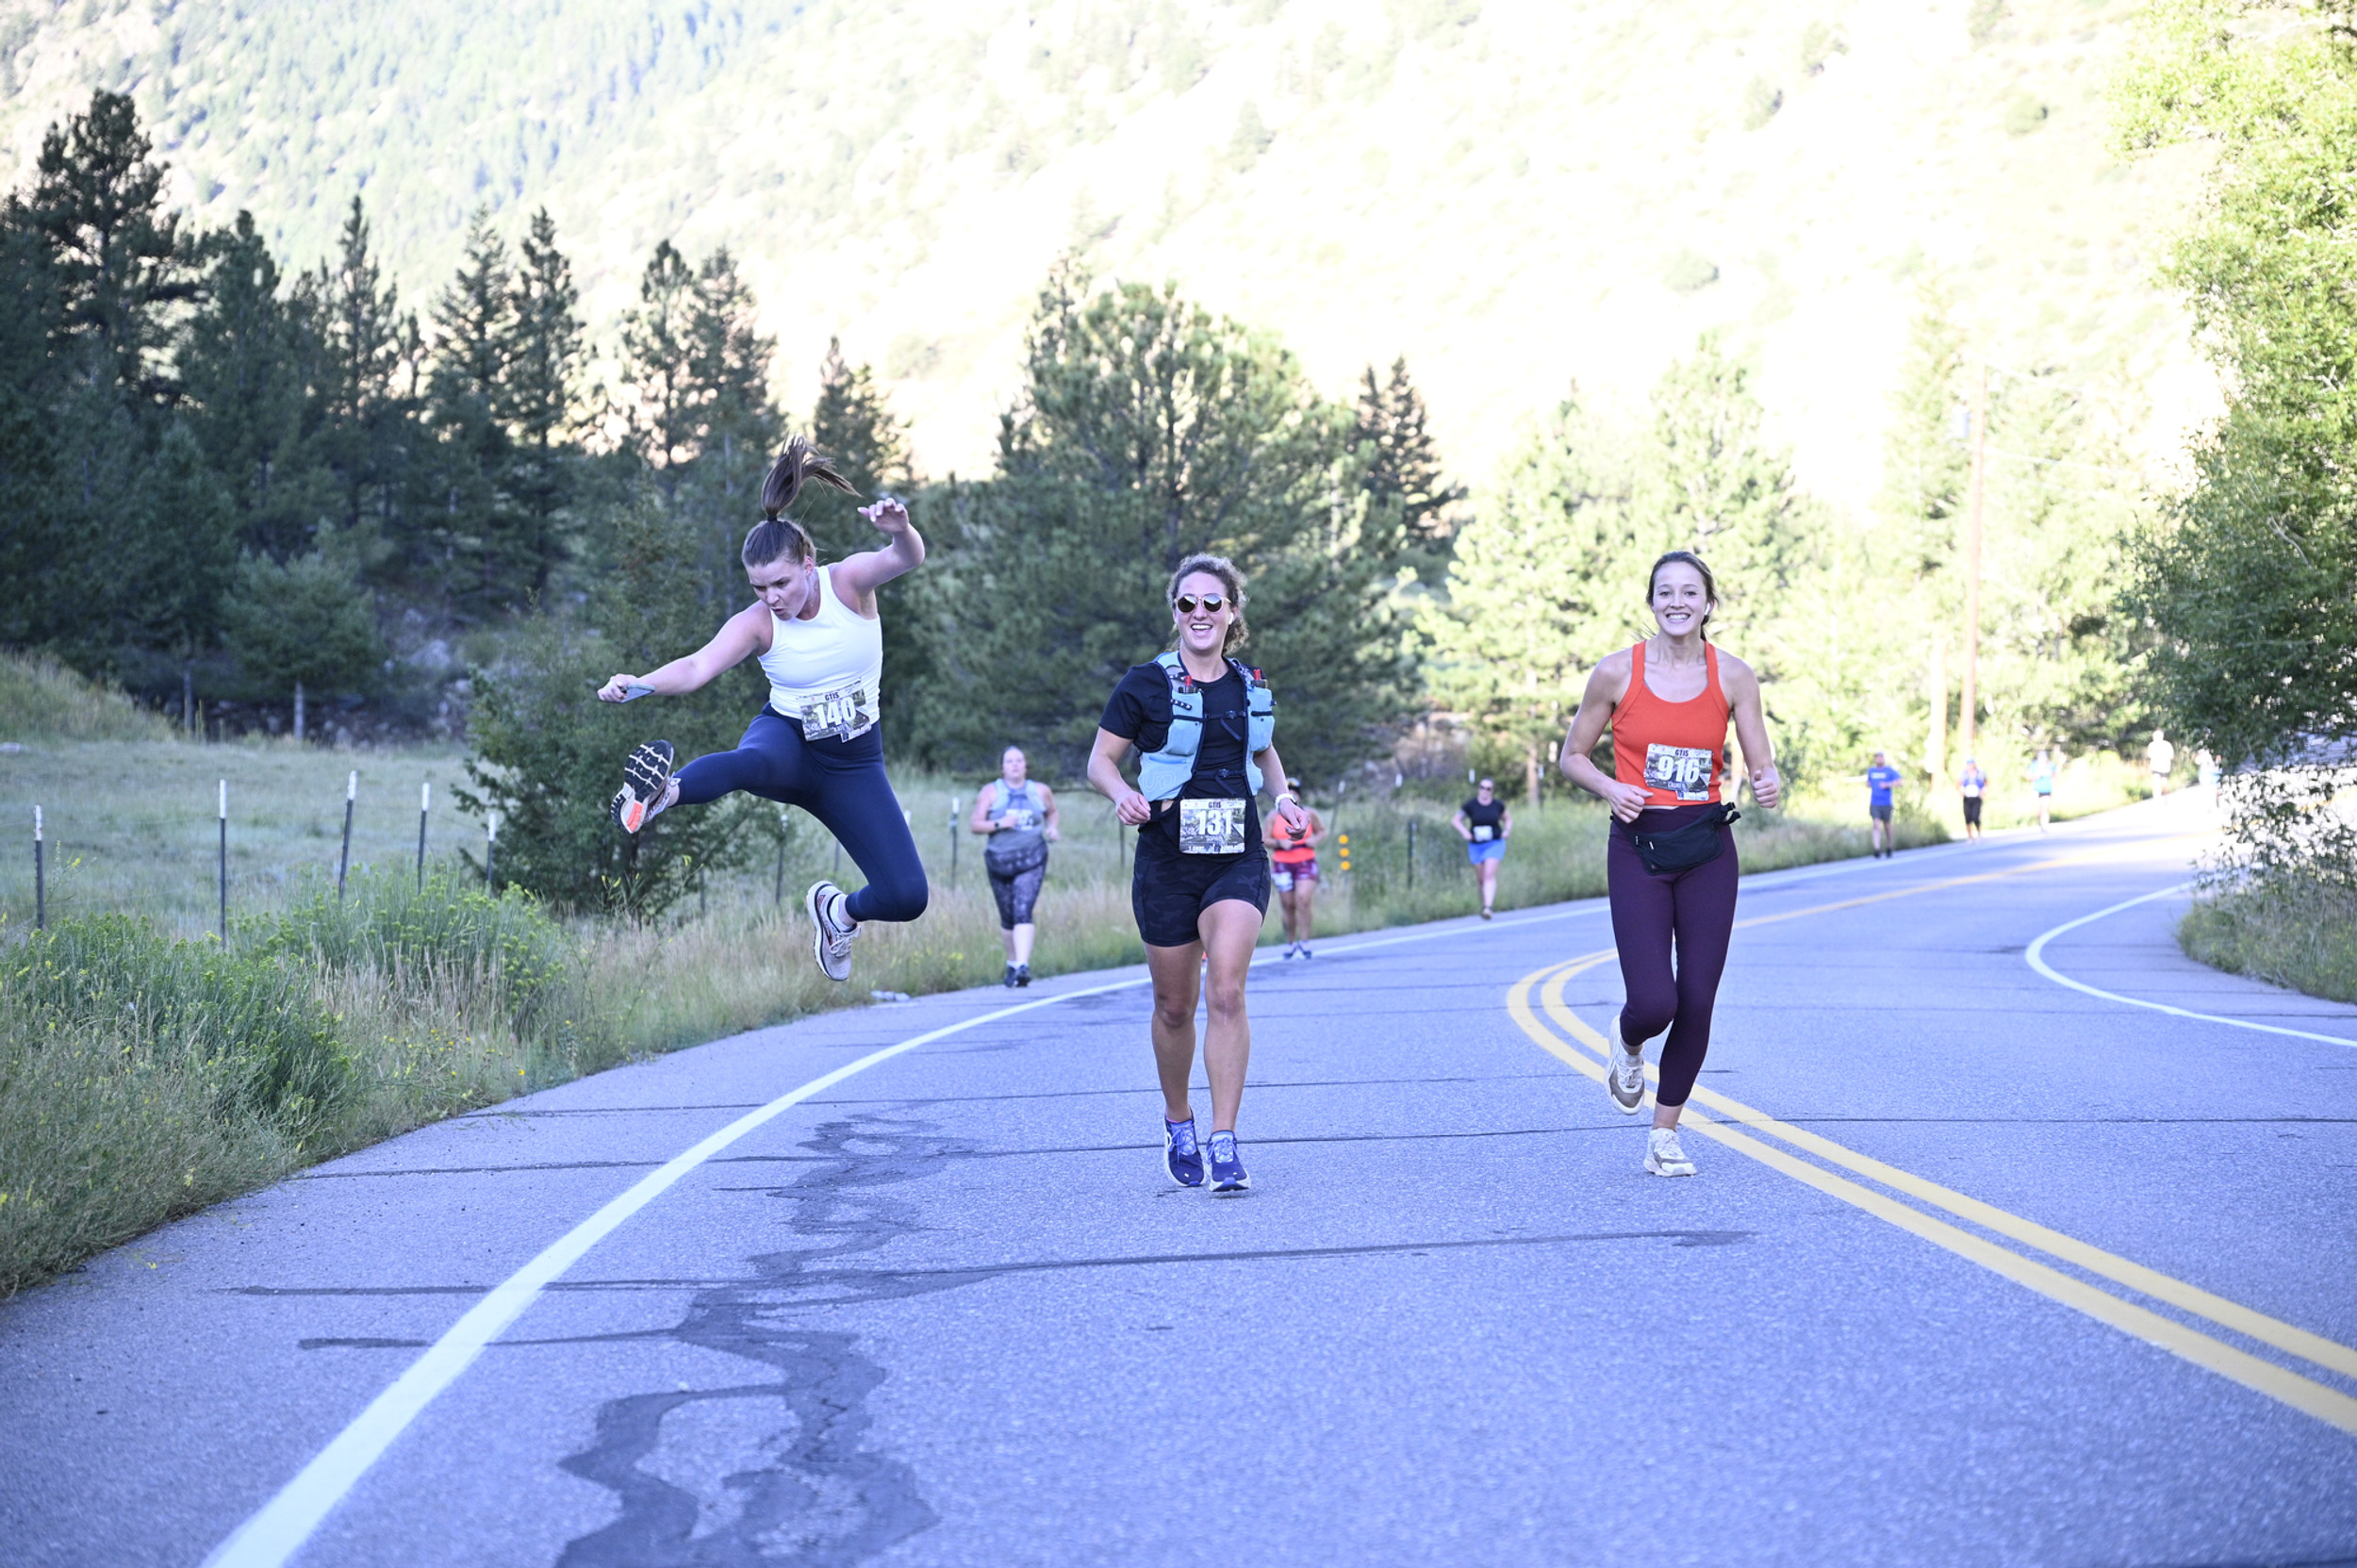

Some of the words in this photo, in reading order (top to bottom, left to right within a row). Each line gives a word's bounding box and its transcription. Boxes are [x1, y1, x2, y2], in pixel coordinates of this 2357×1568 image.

[814, 697, 856, 729] 140
[1674, 749, 1689, 757] GTIS
[1656, 755, 1700, 783] 916
[1195, 809, 1232, 835] 131
